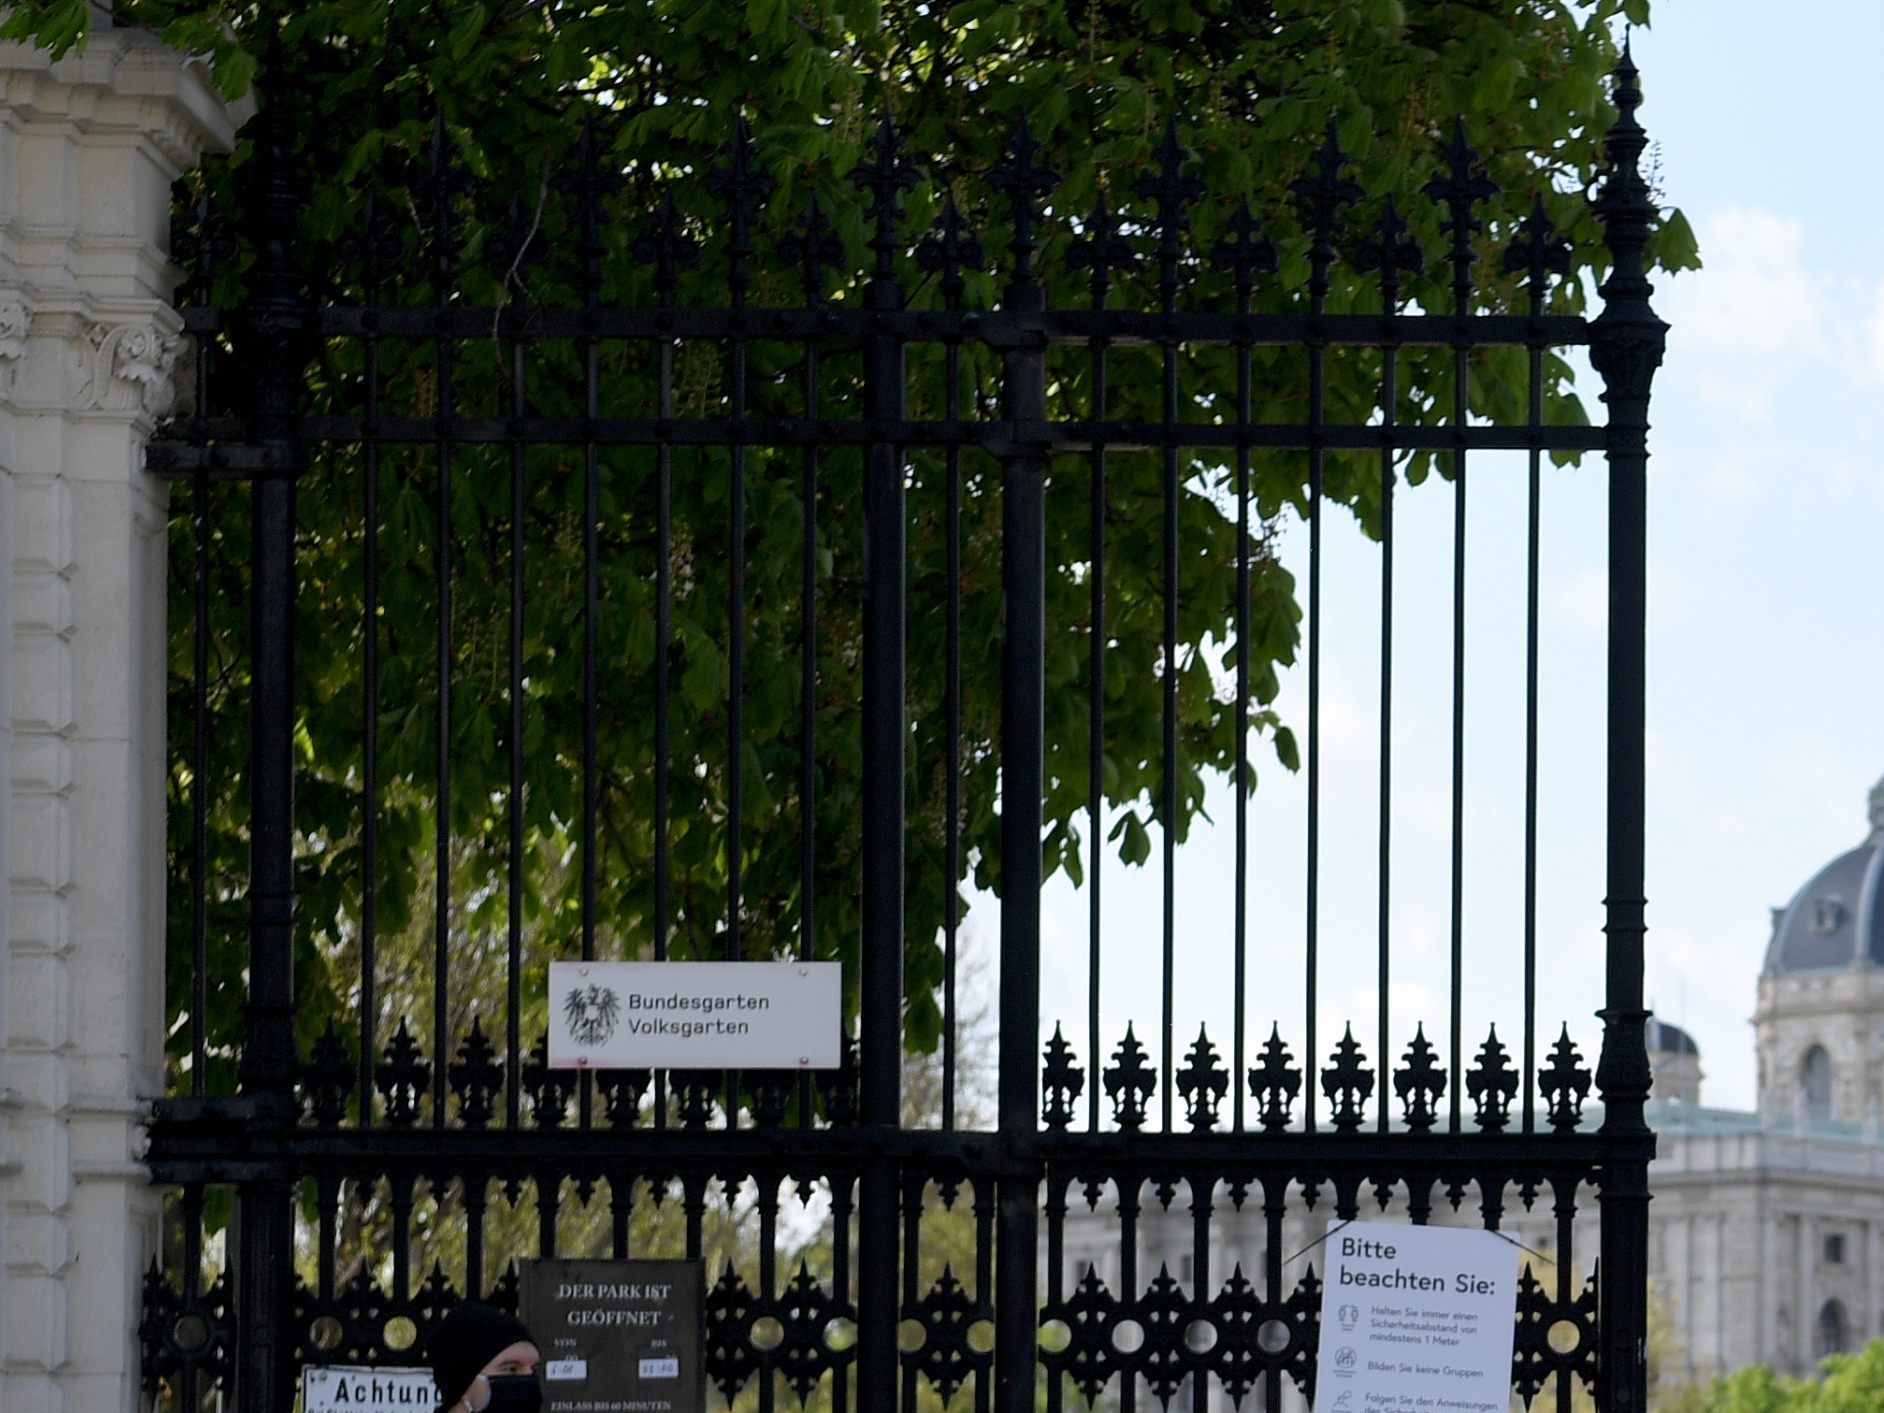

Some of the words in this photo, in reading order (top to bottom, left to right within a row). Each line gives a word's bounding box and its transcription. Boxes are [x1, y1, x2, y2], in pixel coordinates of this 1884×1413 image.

[629, 993, 770, 1011] Bundesgarten
[629, 1018, 749, 1037] Volksgarten
[1341, 1237, 1397, 1260] Bitte
[1339, 1264, 1445, 1292] beachten
[1455, 1273, 1496, 1296] Sie:
[558, 1284, 594, 1299] DER
[598, 1284, 641, 1299] PARK
[644, 1284, 672, 1300] IST
[567, 1307, 662, 1326] GEÖFFNET
[1371, 1305, 1401, 1317] Halten
[1404, 1307, 1420, 1319] Sie
[1421, 1309, 1450, 1320] immer
[1452, 1311, 1479, 1322] einen
[1370, 1318, 1458, 1334] Sicherheitsabstand
[1460, 1325, 1478, 1335] von
[1369, 1332, 1422, 1345] mindestens
[1432, 1336, 1460, 1347] Meter
[1367, 1360, 1396, 1372] Bilden
[1399, 1362, 1413, 1374] Sie
[1415, 1364, 1441, 1376] keine
[1442, 1366, 1484, 1380] Gruppen
[1365, 1392, 1397, 1406] Folgen
[1399, 1395, 1413, 1405] Sie
[1416, 1396, 1434, 1407] den
[1436, 1398, 1499, 1413] Anweisungen
